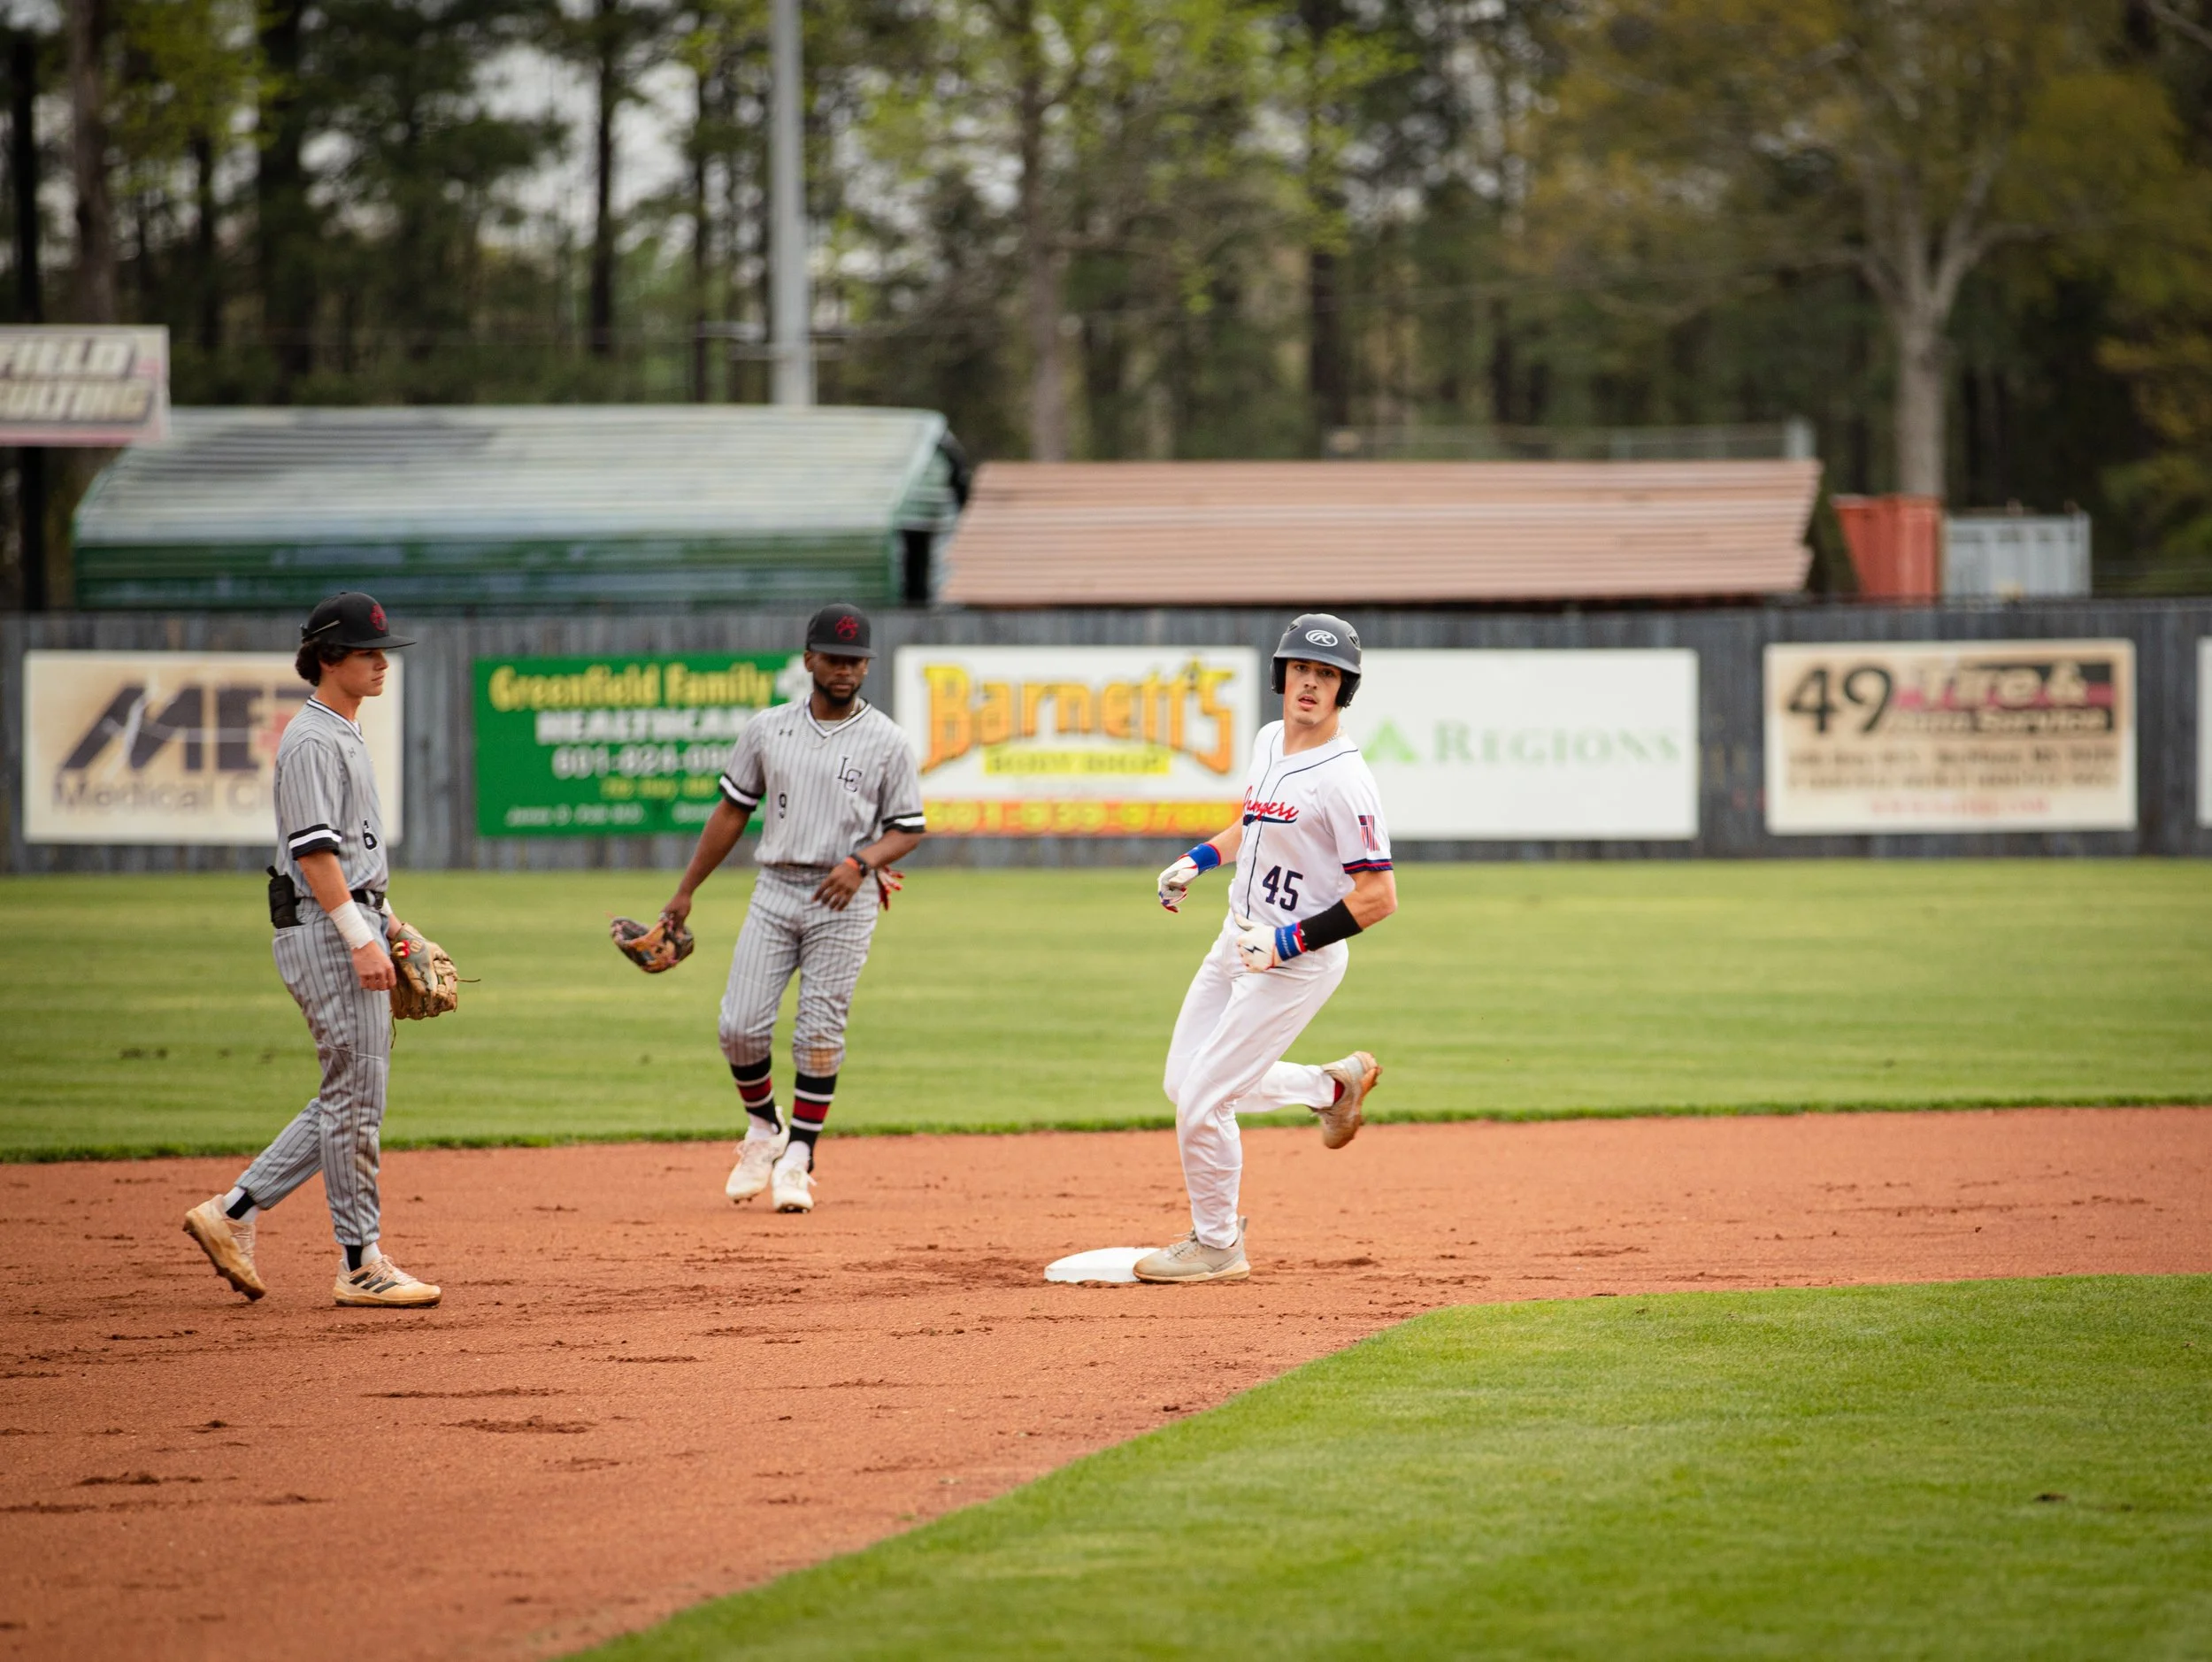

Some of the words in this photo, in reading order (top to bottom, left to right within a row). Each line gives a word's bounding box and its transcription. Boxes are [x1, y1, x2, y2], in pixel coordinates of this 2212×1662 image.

[489, 665, 661, 712] Greenfield
[664, 662, 773, 708] Family
[1788, 663, 1893, 735] 49
[535, 708, 761, 745] HEALTHCAR
[1433, 719, 1681, 763] REGIONS
[54, 779, 212, 815] Medical
[779, 793, 787, 819] 9
[362, 819, 378, 850] 6
[1262, 865, 1303, 912] 45
